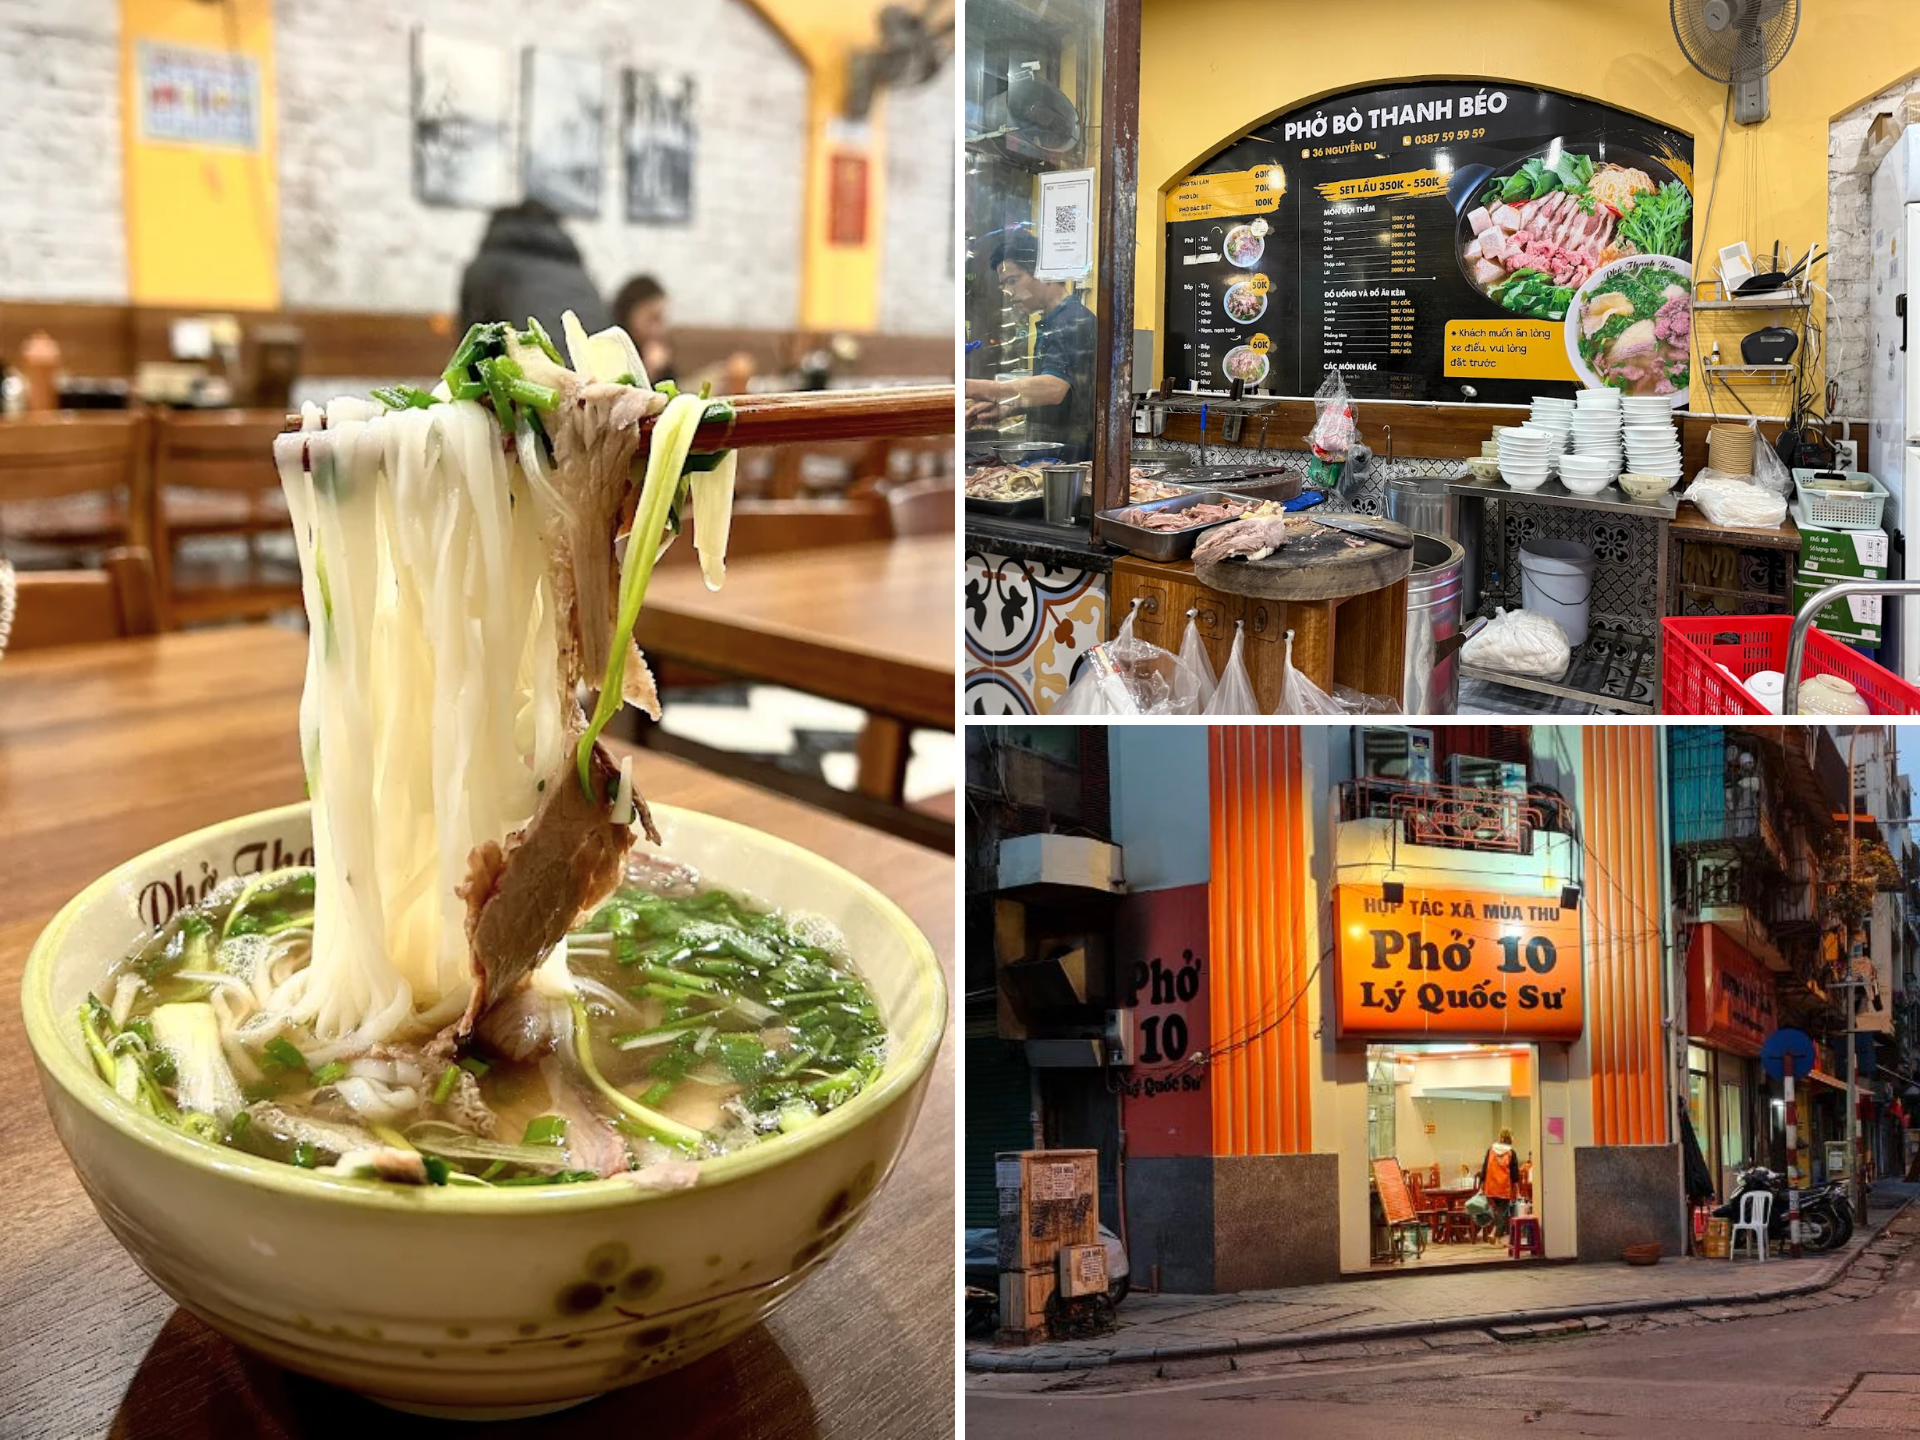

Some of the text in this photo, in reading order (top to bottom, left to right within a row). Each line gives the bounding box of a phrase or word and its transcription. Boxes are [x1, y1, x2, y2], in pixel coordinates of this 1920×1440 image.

[1285, 88, 1509, 141] PHỞ BÒ THANH BÉO
[1415, 127, 1486, 145] 0387 59 59 59
[1312, 140, 1377, 158] 36 NGUYỄN DU
[1255, 169, 1270, 179] 60K
[1255, 184, 1270, 193] 70K
[1340, 185, 1355, 195] SET
[1358, 179, 1377, 193] LẨU
[1379, 180, 1404, 191] 350K
[1414, 176, 1440, 188] 550K
[1255, 197, 1273, 207] 100K
[1324, 204, 1376, 216] MÓN GỌI THÊM
[1625, 259, 1656, 270] Thanh
[1252, 281, 1267, 289] 50K
[1324, 288, 1335, 298] ĐỒ
[1336, 287, 1357, 298] UỐNG
[1358, 288, 1368, 297] VÀ
[1370, 286, 1380, 297] ĐỒ
[1391, 287, 1406, 297] KÈM
[1459, 326, 1551, 340] Khách muốn ăn lòng
[1253, 341, 1268, 349] 60K
[1451, 344, 1462, 352] xe
[1490, 345, 1504, 353] vui
[1507, 344, 1527, 356] lòng
[1324, 361, 1377, 371] CÁC MÓN KHÁC
[1450, 357, 1497, 369] đặt trước
[1410, 899, 1444, 917] TÁC
[1451, 900, 1475, 919] XÃ
[1483, 900, 1523, 921] MÙA
[1527, 906, 1560, 922] THU
[1370, 928, 1557, 974] Phở 10
[1124, 949, 1202, 1008] Phở
[1360, 978, 1566, 1014] Lý Quốc Sư
[1139, 1013, 1188, 1064] 10
[1144, 1071, 1180, 1098] Quốc
[1182, 1072, 1205, 1092] Sư
